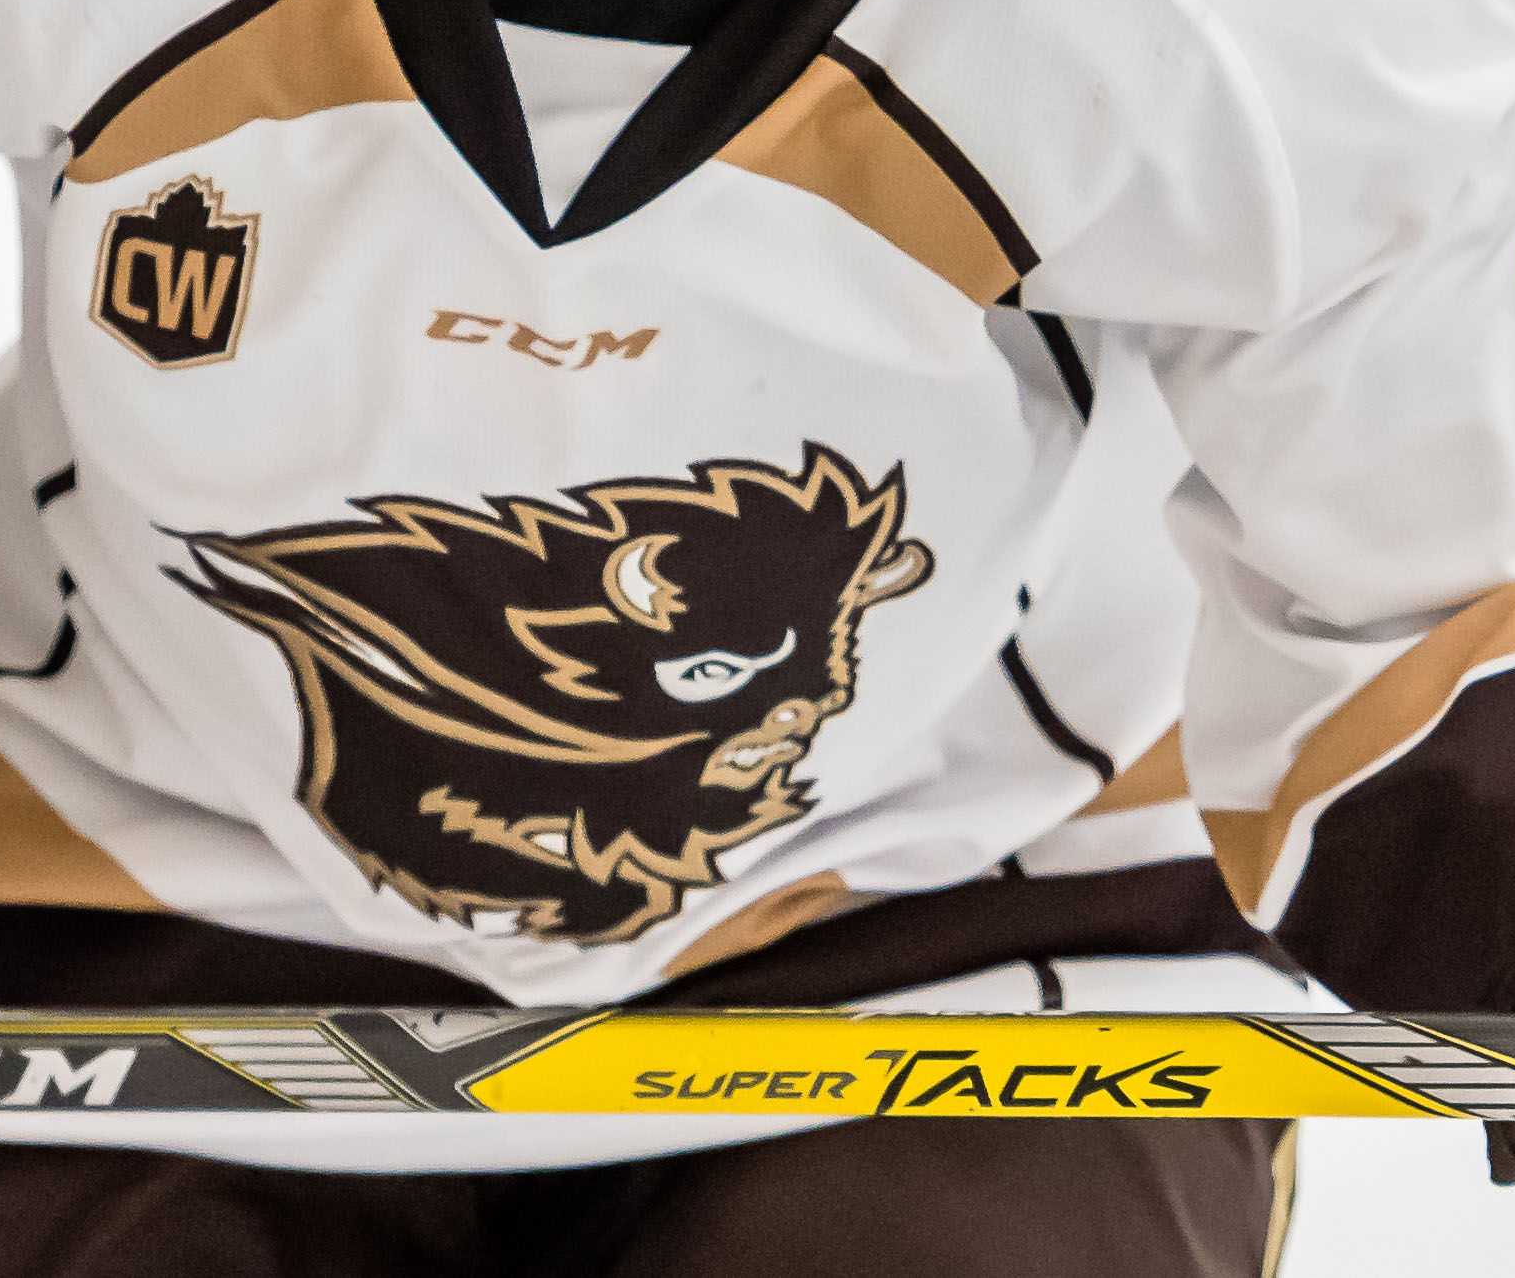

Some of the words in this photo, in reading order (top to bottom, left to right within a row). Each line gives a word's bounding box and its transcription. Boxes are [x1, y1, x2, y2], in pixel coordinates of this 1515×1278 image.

[112, 237, 237, 340] CW
[424, 308, 661, 371] CCM
[632, 1070, 860, 1100] SUPER
[865, 1049, 1223, 1115] TACKS
